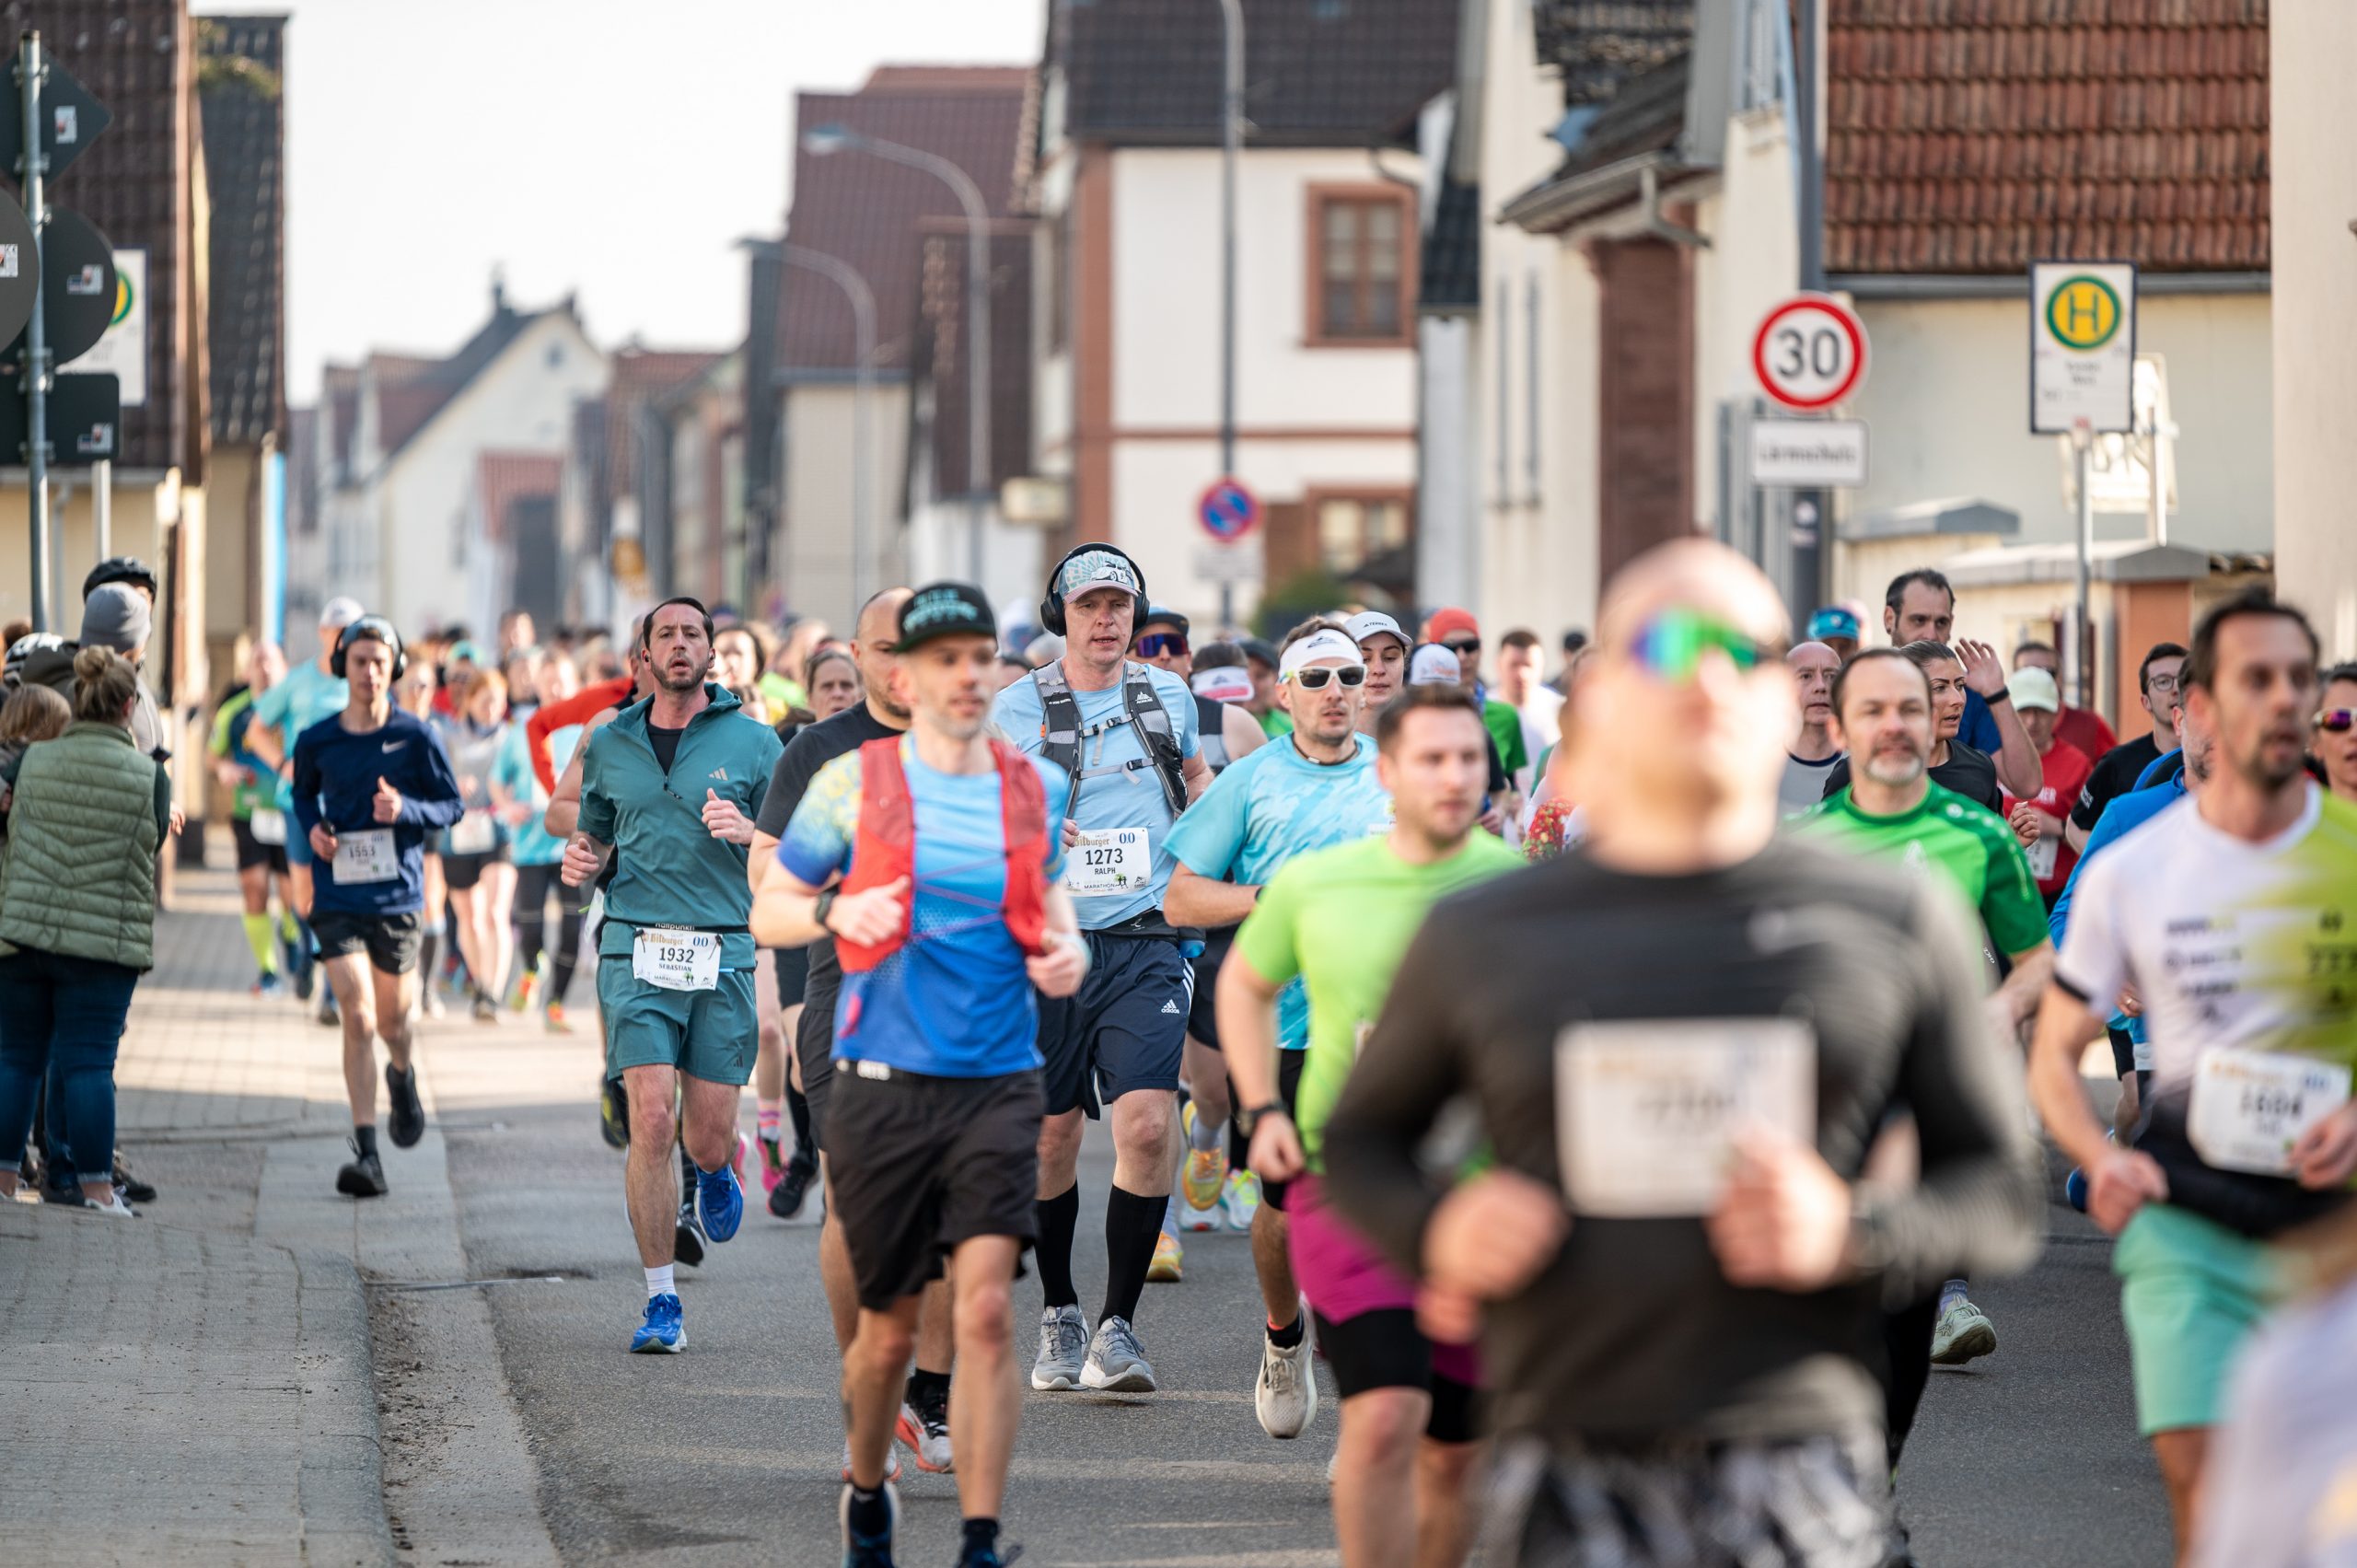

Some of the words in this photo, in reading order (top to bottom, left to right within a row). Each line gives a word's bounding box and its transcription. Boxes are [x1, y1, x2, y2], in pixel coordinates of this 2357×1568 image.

[2069, 292, 2100, 332] H
[1776, 327, 1840, 379] 30
[1085, 847, 1123, 865] 1273
[1094, 866, 1116, 876] RALPH
[659, 947, 695, 963] 1932
[659, 964, 691, 972] SEBASTIAN
